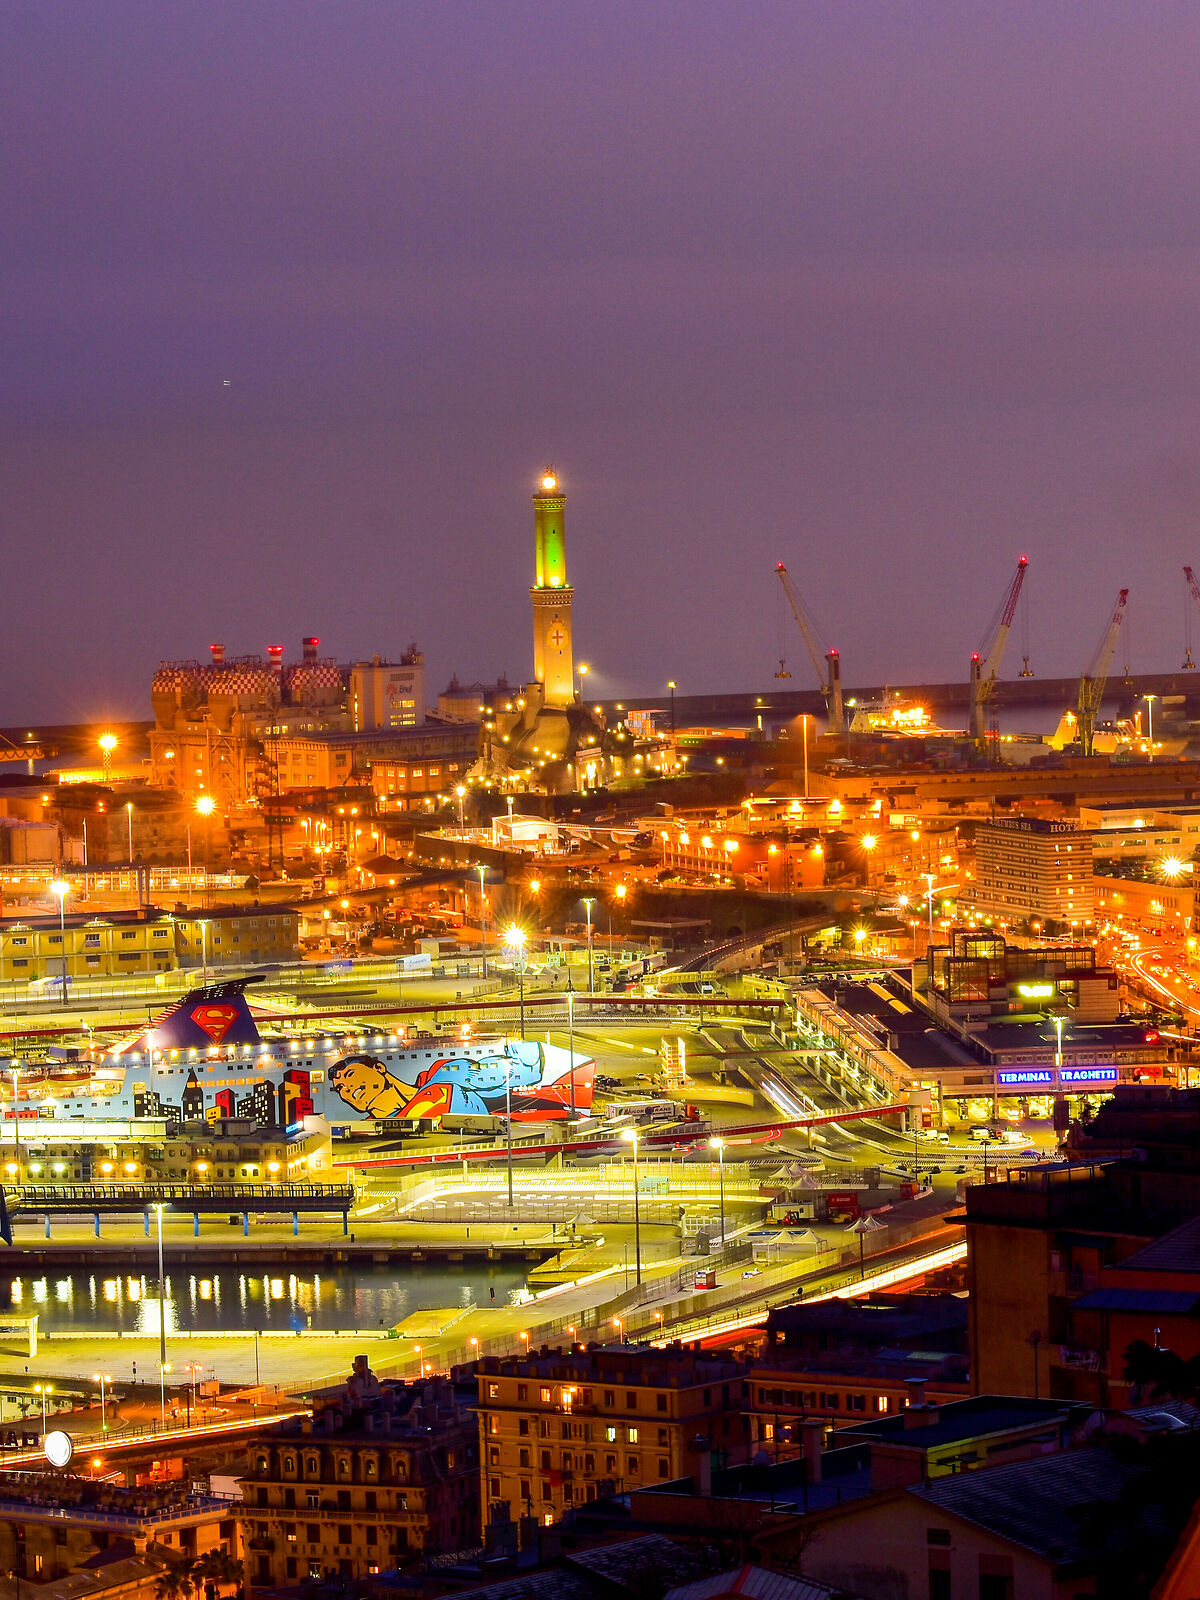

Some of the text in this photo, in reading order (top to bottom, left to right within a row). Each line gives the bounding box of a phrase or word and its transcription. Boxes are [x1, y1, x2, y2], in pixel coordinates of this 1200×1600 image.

[1000, 1070, 1115, 1083] TERMINAL TRAGHETTI
[291, 1544, 374, 1558] MIRAMARE
